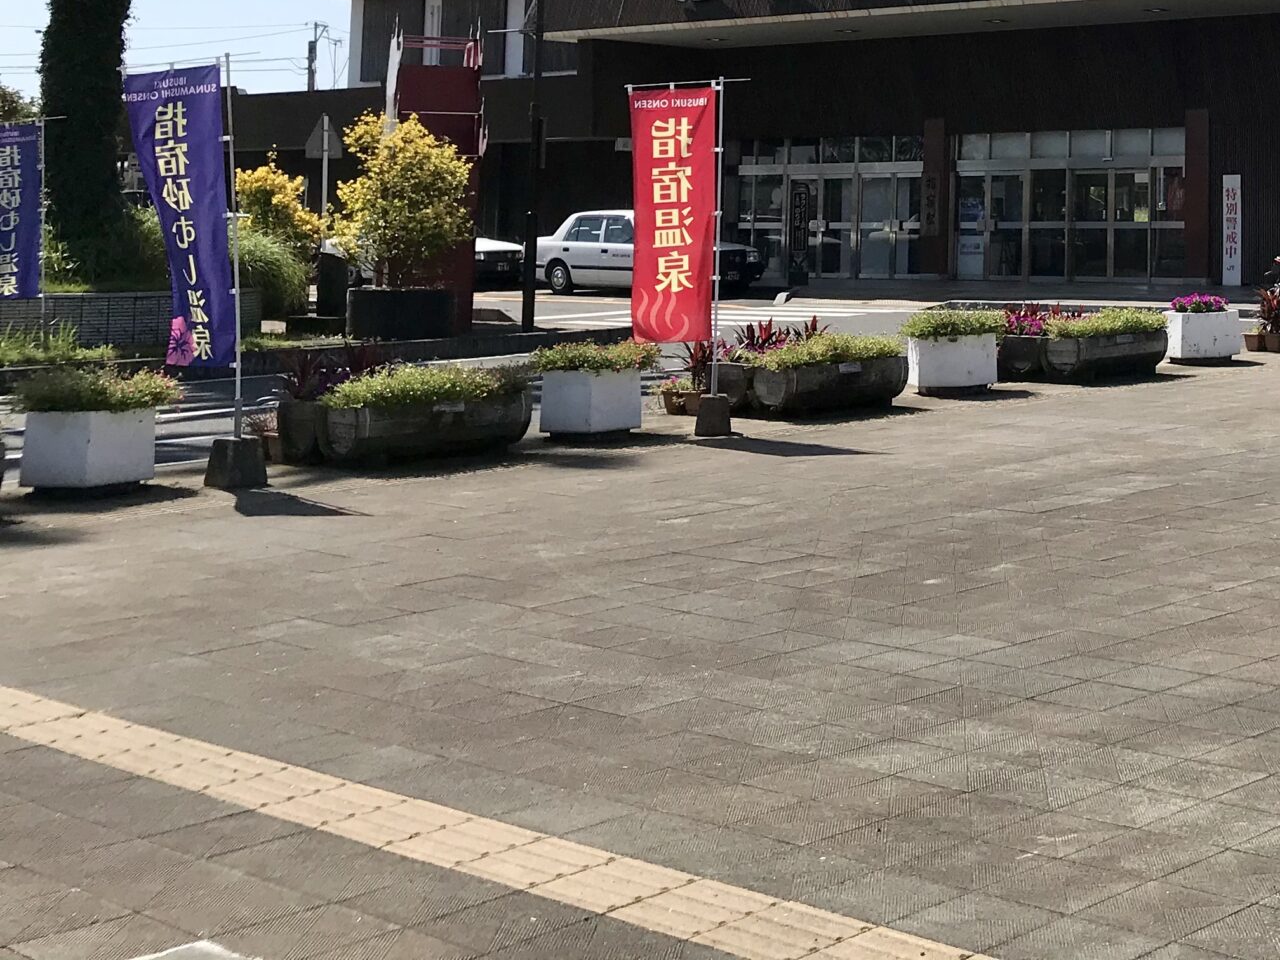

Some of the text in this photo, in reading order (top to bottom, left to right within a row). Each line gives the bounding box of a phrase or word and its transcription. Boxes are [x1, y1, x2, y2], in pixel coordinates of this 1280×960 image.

[1224, 187, 1238, 259] 特別警戒中
